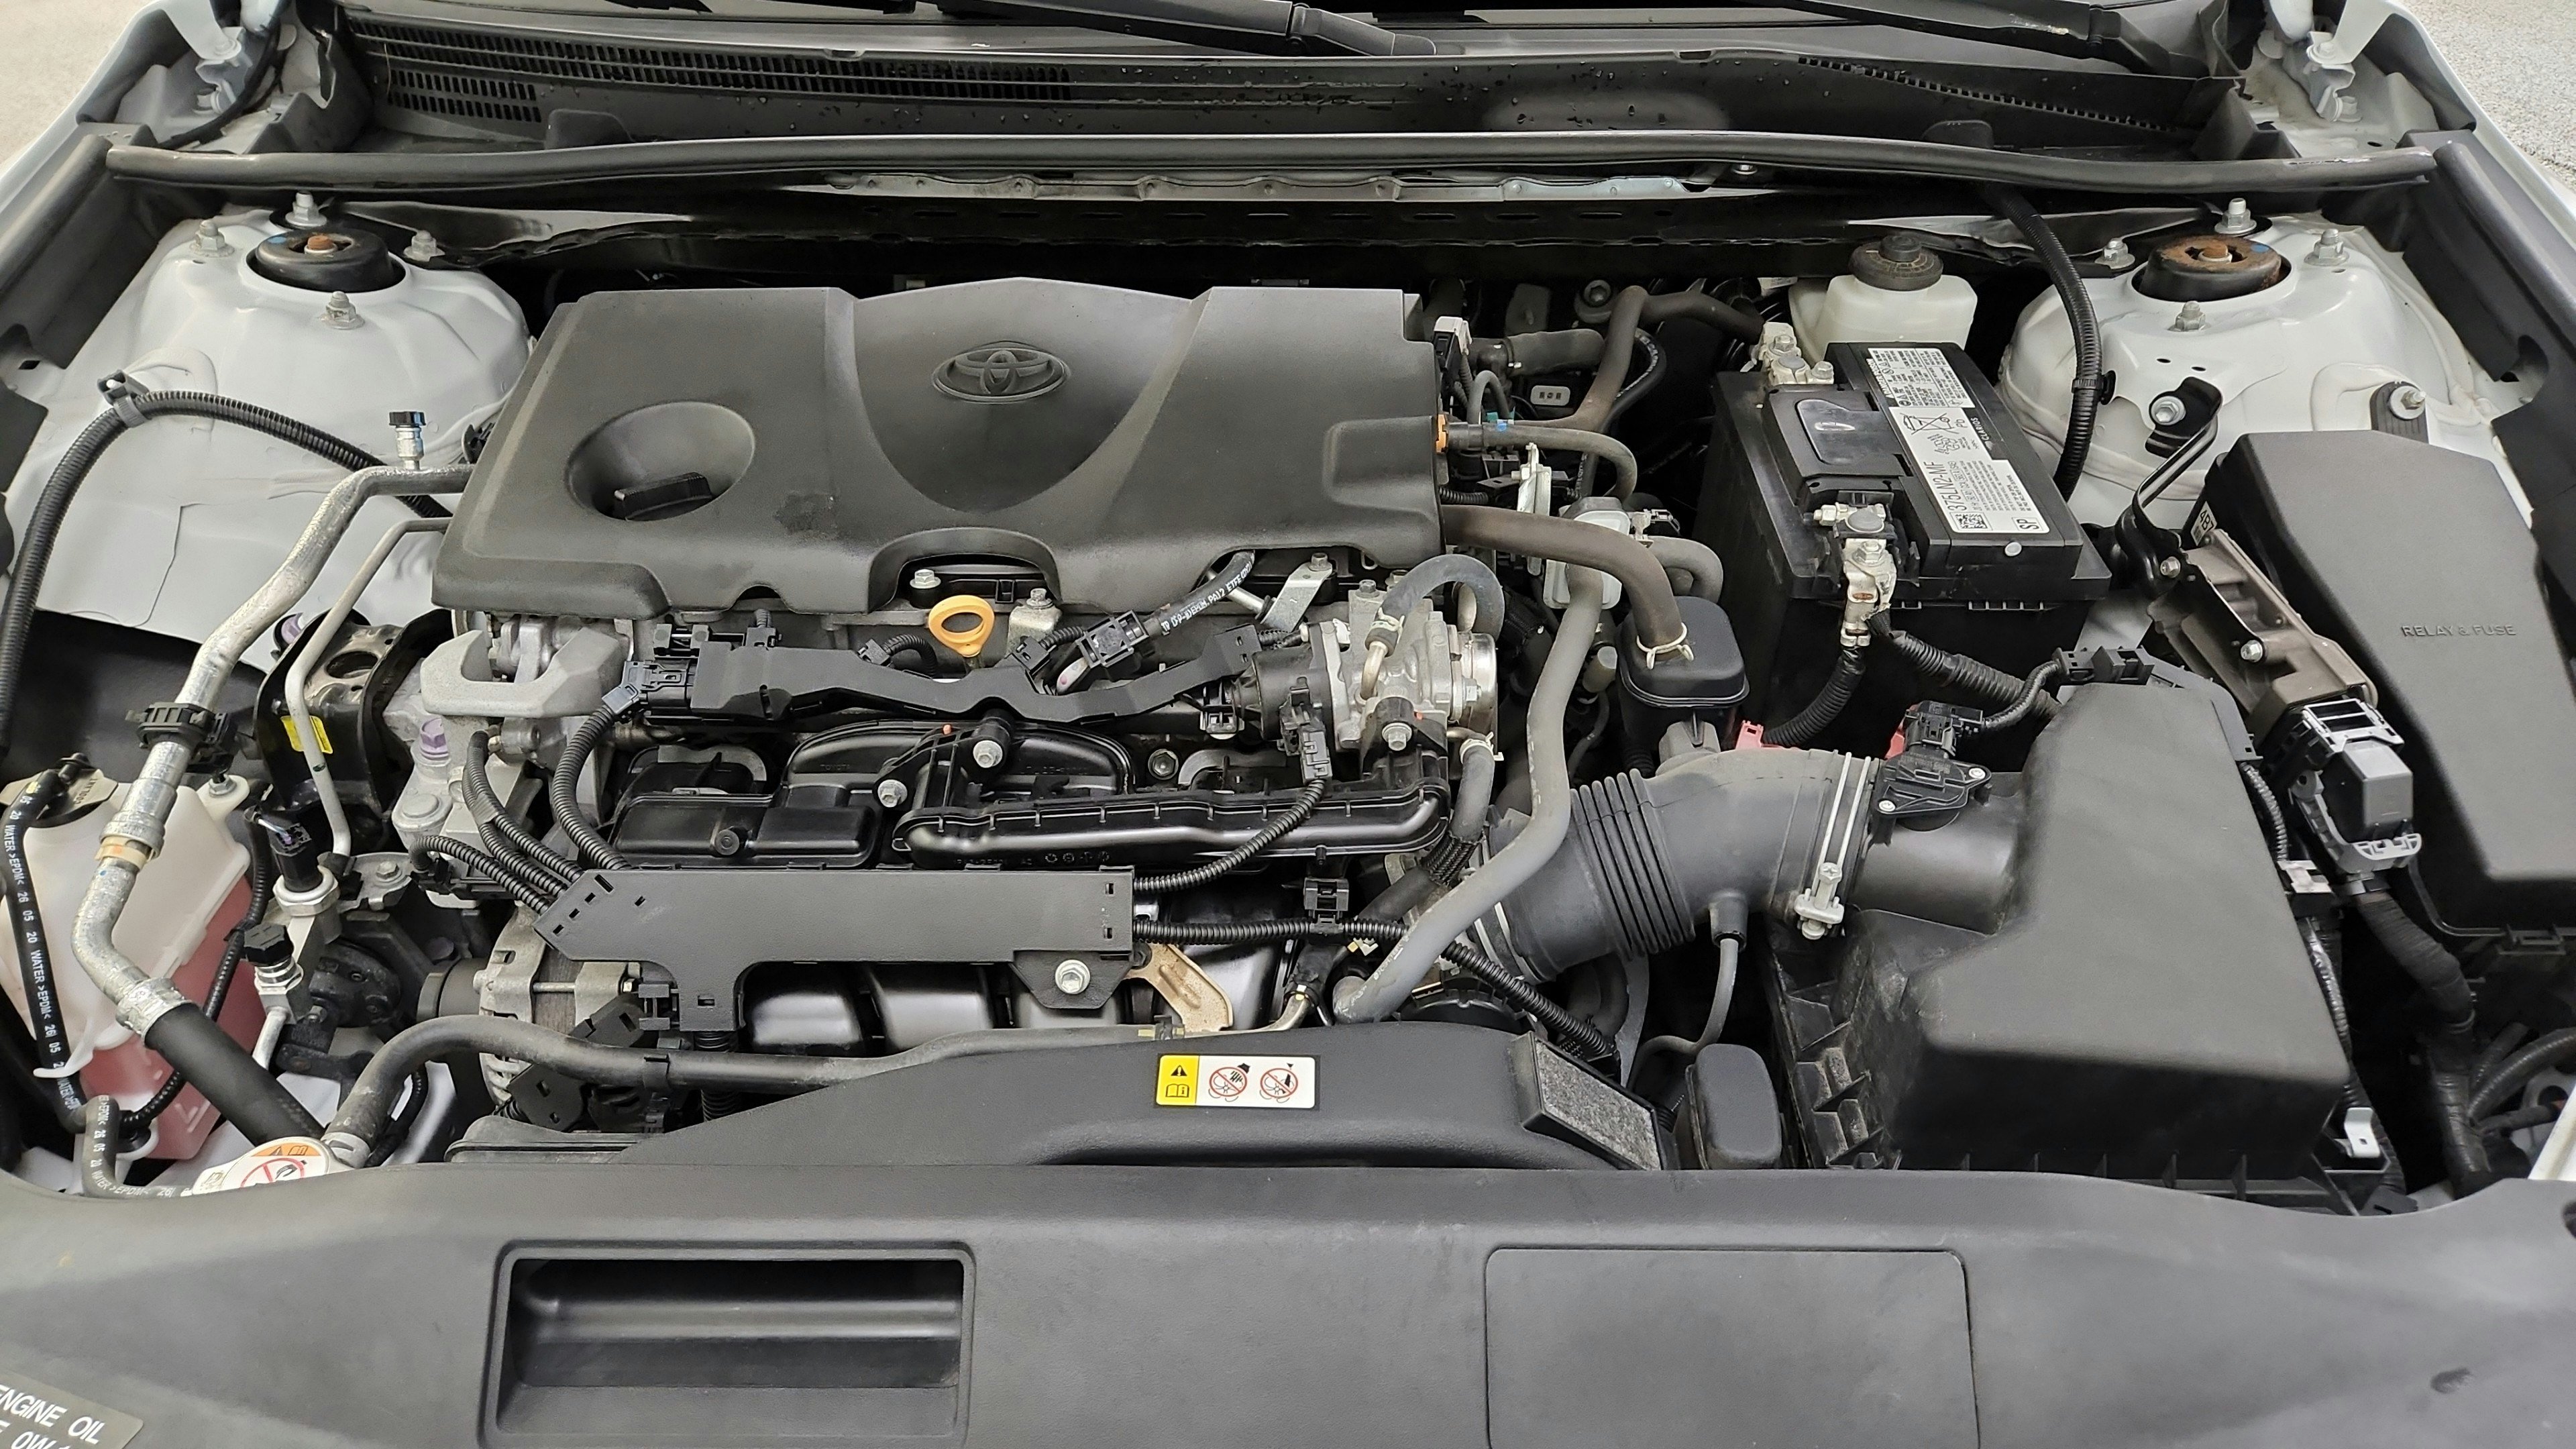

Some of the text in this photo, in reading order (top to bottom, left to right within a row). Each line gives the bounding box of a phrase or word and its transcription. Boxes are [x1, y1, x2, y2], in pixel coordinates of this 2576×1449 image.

[1954, 419, 1968, 428] Pb
[1971, 417, 1989, 440] CLARIOS
[1923, 462, 1967, 511] 375LN2-MF
[2016, 519, 2039, 530] SP
[2402, 625, 2516, 637] RELAY & FUSE
[74, 778, 97, 804] COOLANT
[19, 796, 33, 805] 05
[9, 810, 21, 820] 20
[4, 824, 16, 853] WATER
[17, 892, 29, 903] 26
[23, 910, 34, 922] 05
[26, 931, 38, 943] 20
[30, 950, 45, 983] WATER
[49, 1042, 61, 1053] 05
[68, 1416, 105, 1444] OIL
